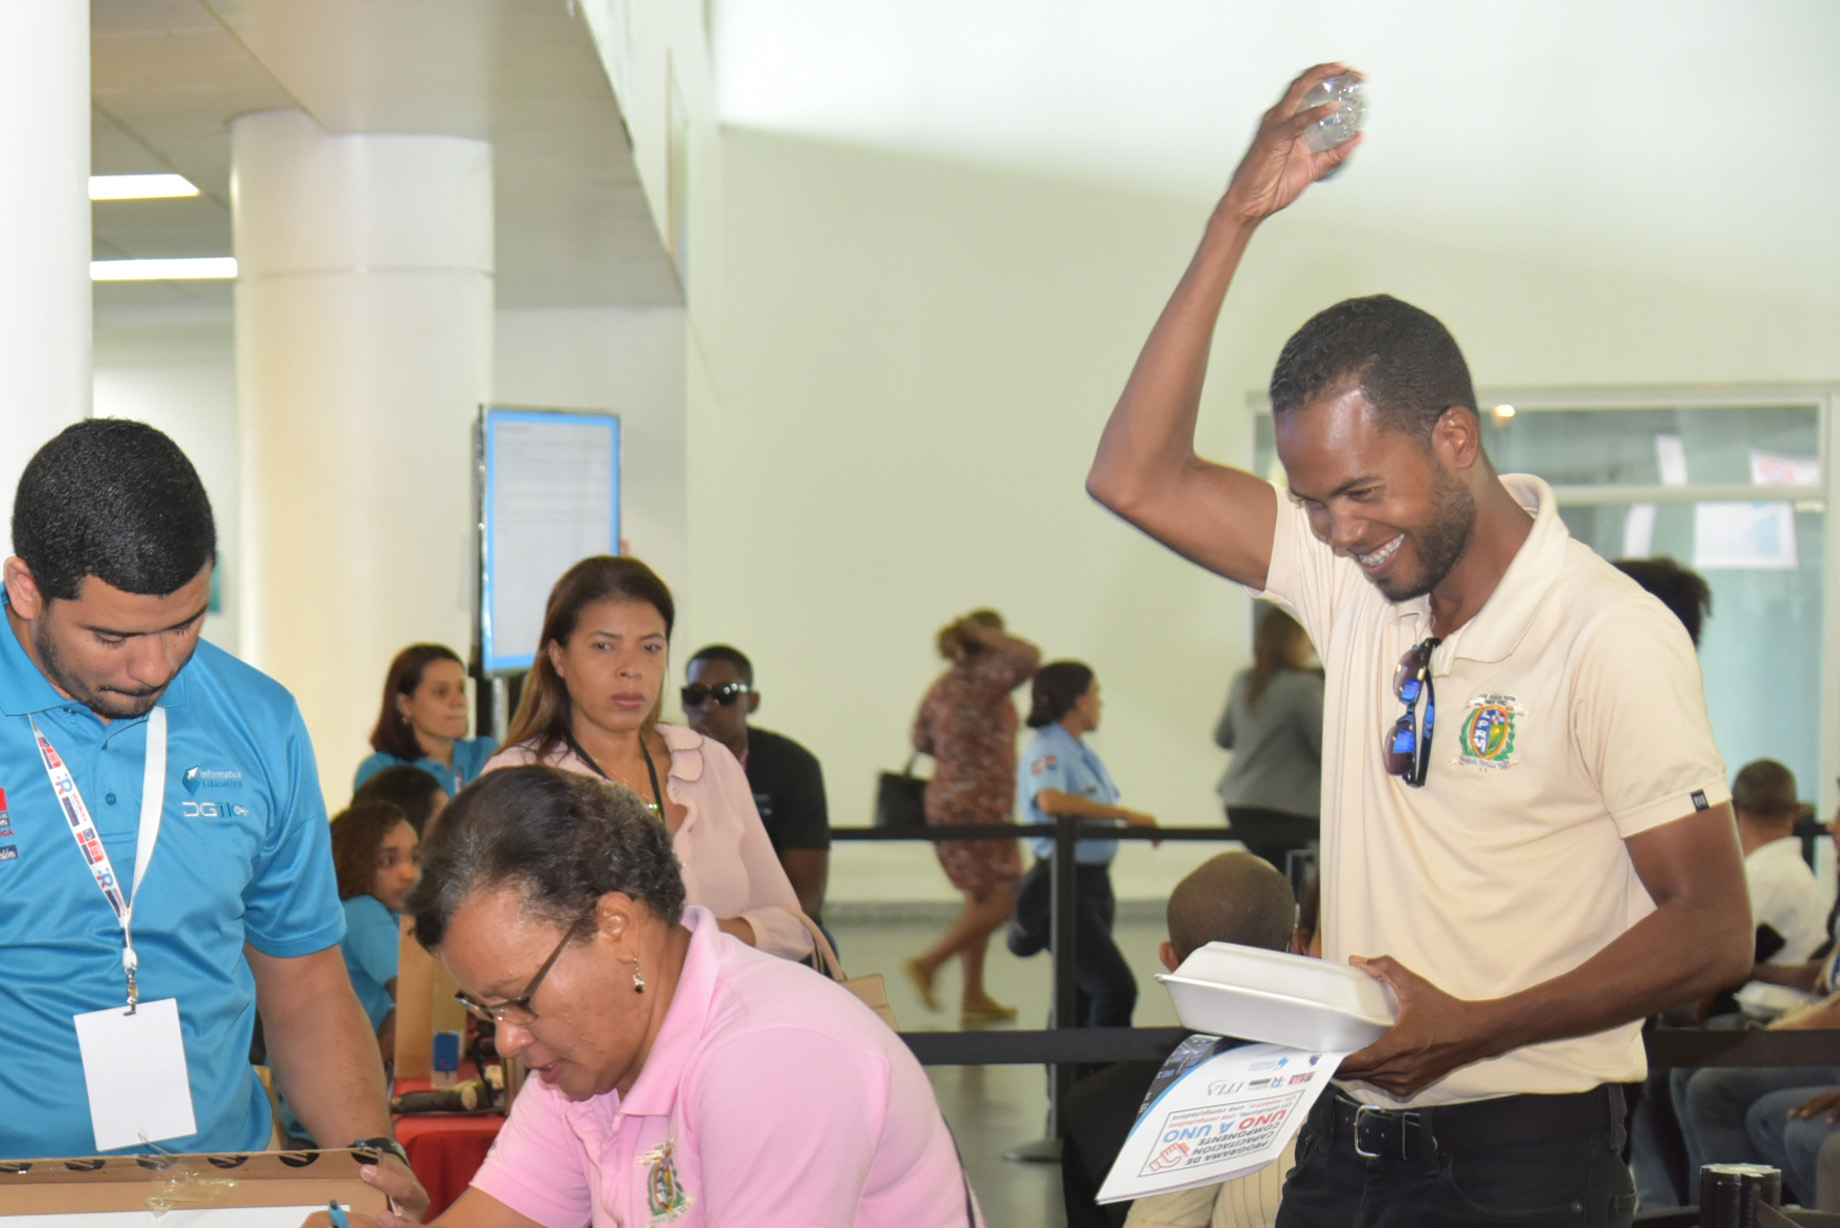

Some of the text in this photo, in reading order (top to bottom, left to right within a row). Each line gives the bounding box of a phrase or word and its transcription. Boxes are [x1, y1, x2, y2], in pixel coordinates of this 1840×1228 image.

[1163, 1109, 1287, 1143] UNO A UNO
[1198, 1121, 1280, 1146] COMPONENTE
[1185, 1140, 1268, 1166] PROGRAMA DE
[1193, 1130, 1274, 1156] CAPACITACIÓN
